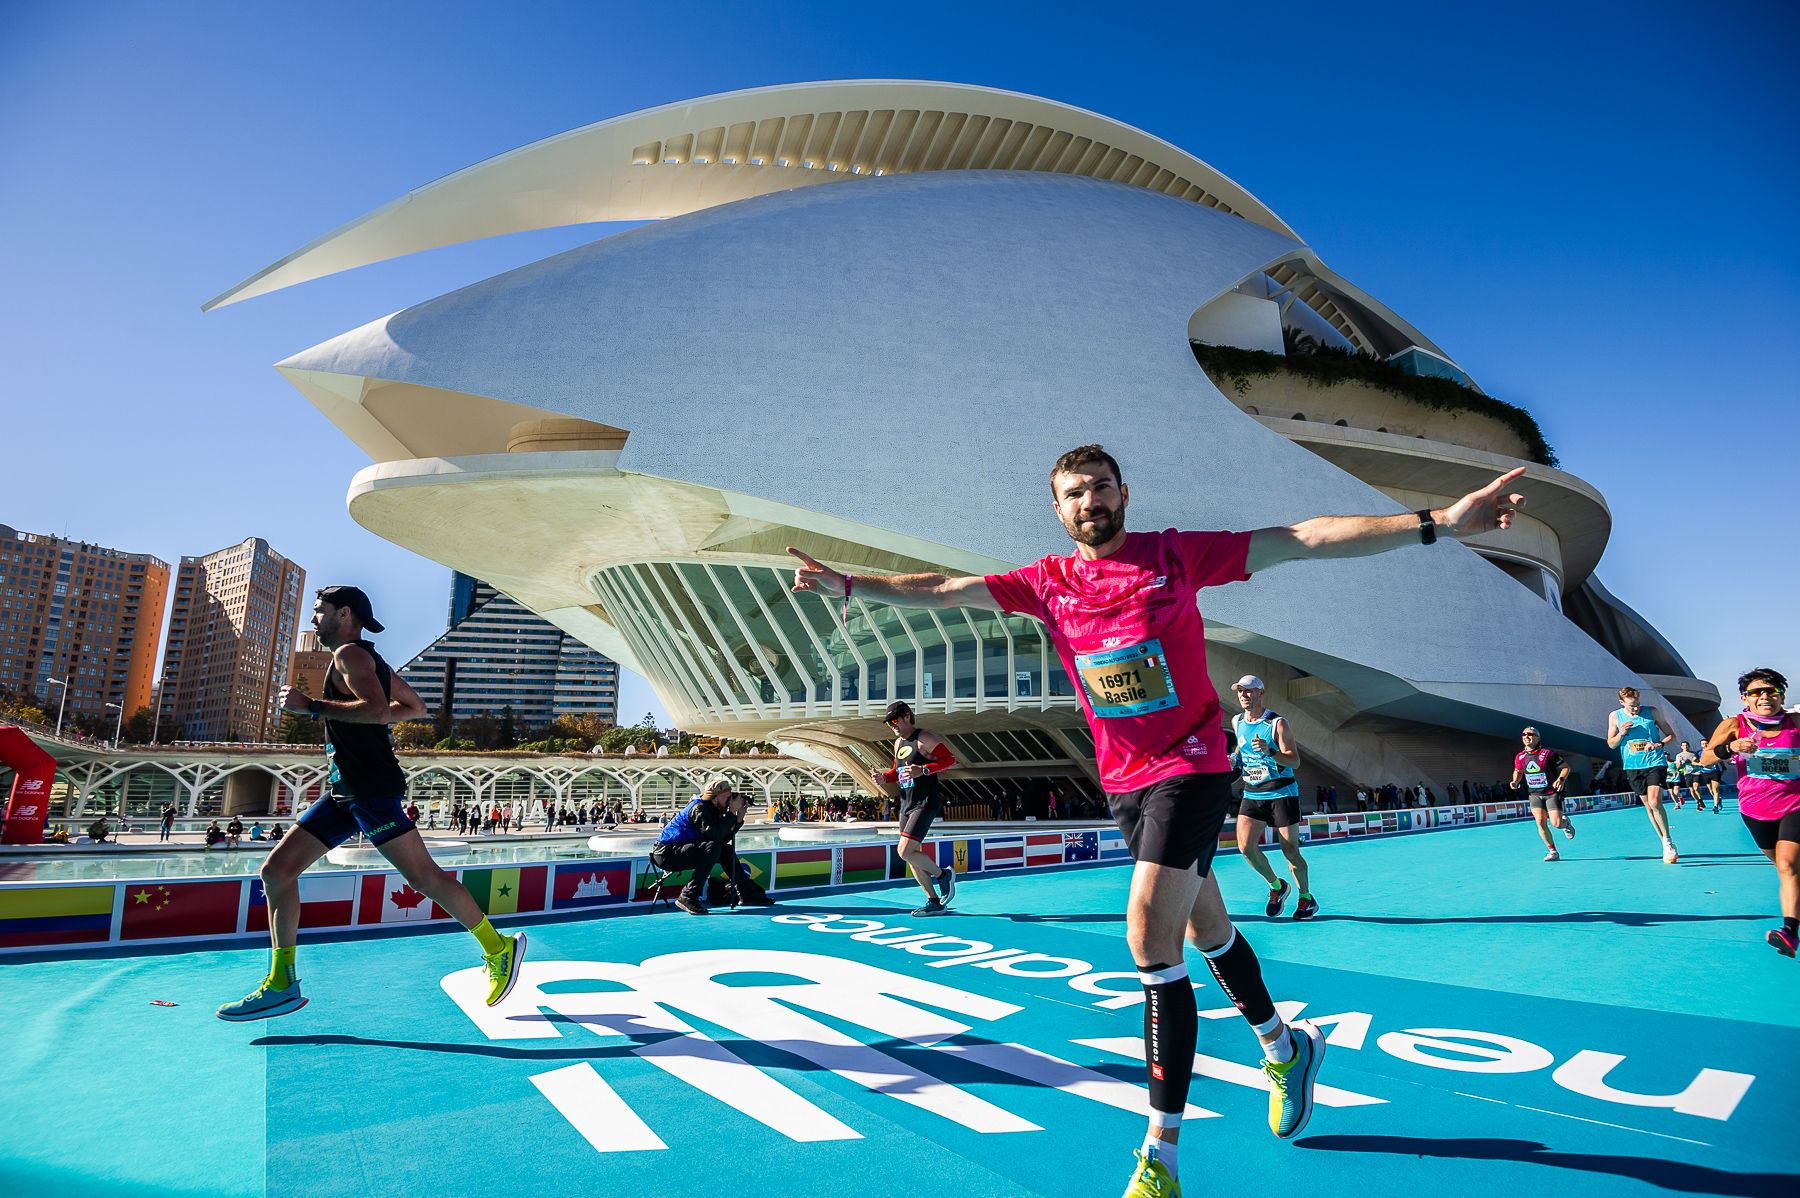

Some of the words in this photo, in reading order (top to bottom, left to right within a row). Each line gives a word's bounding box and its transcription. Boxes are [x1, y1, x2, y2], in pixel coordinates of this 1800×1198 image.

[1098, 669, 1142, 689] 16971
[1104, 687, 1147, 704] Basile
[500, 951, 510, 977] HOKA
[770, 913, 1207, 1010] balance
[1150, 989, 1159, 1062] COMPRESSPORT
[1197, 1000, 1757, 1122] new
